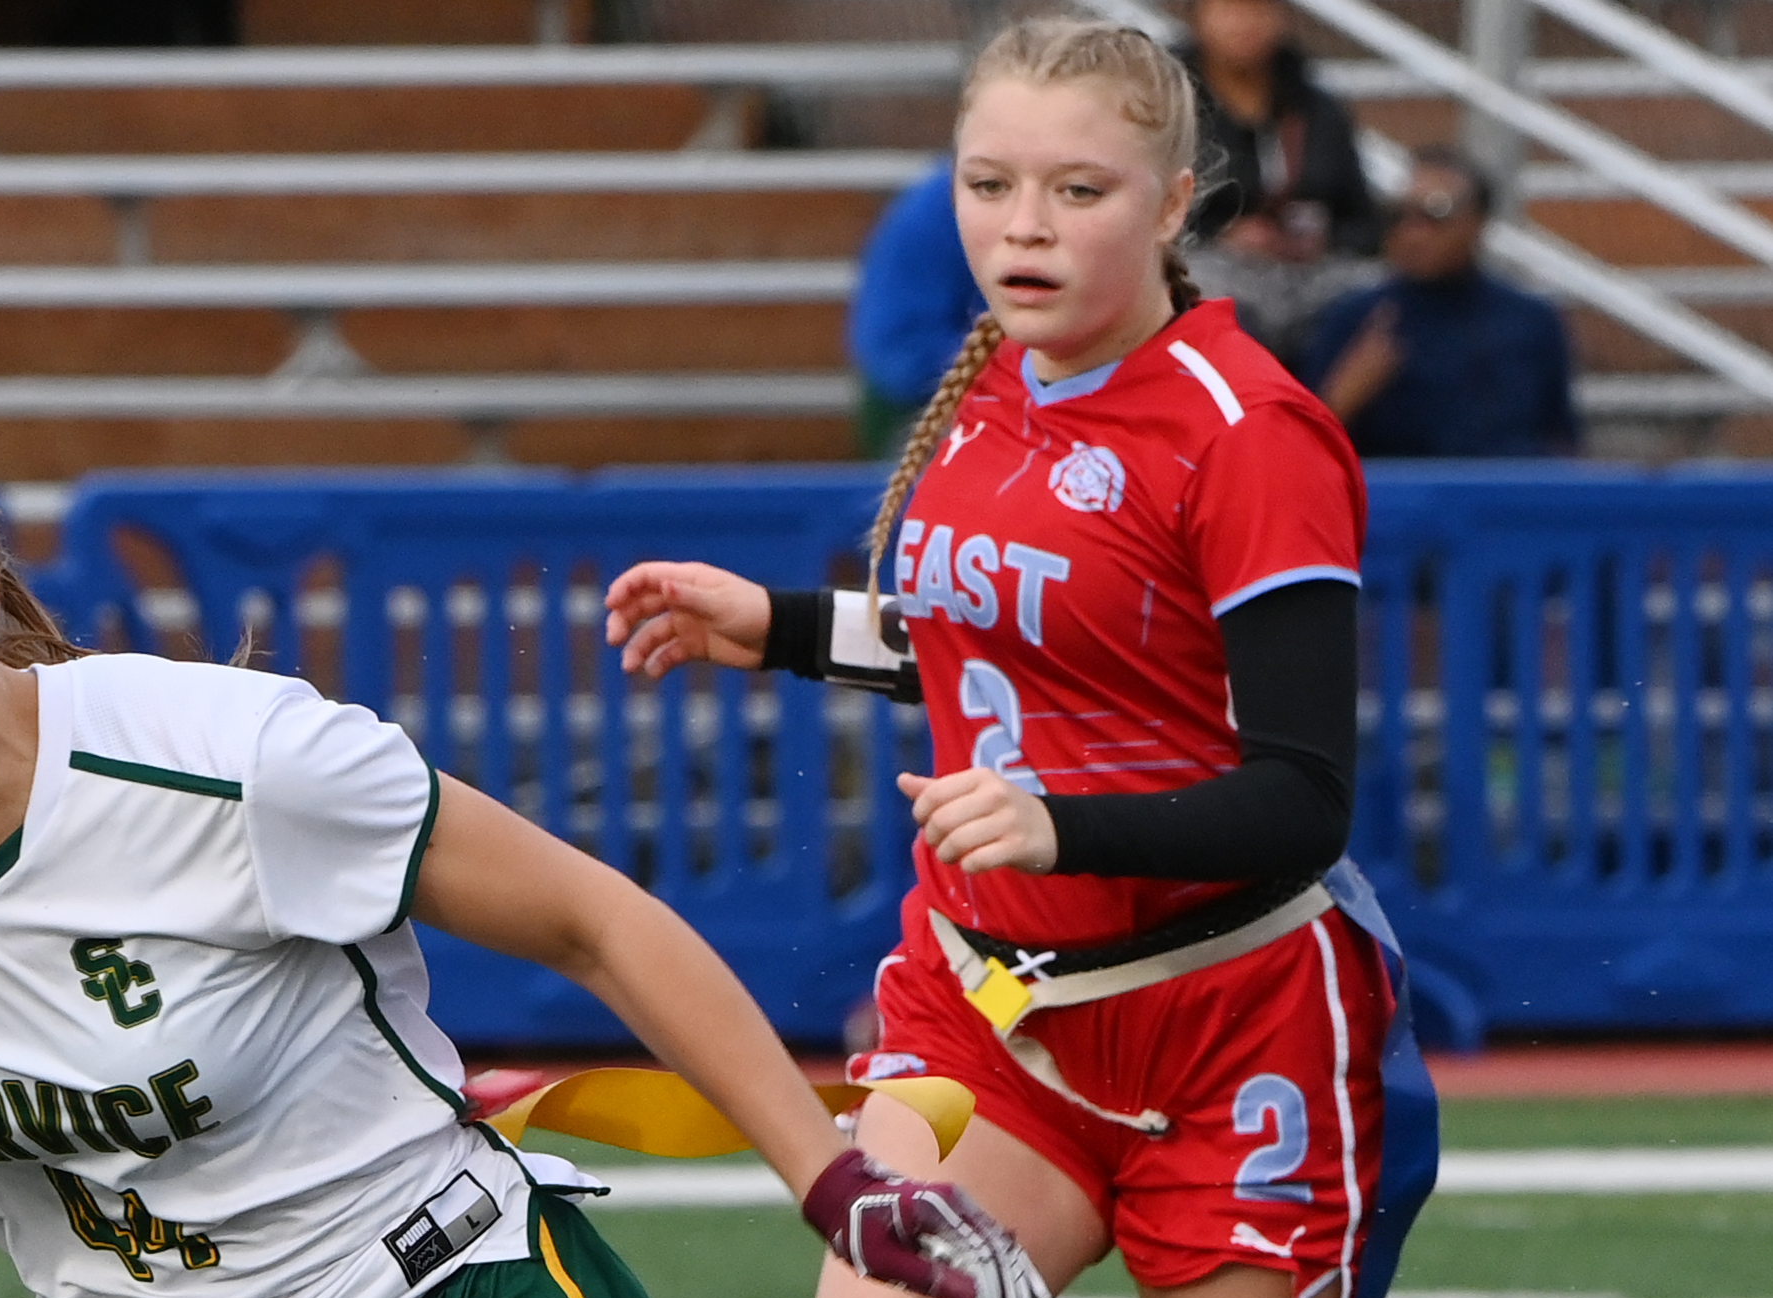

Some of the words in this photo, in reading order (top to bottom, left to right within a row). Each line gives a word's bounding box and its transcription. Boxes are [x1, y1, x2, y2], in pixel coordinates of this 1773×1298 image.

[895, 519, 1071, 646] EAST
[959, 658, 1047, 796] 2
[70, 938, 163, 1030] SC
[1232, 1073, 1315, 1204] 2
[43, 1164, 220, 1282] 44
[394, 1215, 434, 1254] PUMA
[464, 1213, 481, 1231] L
